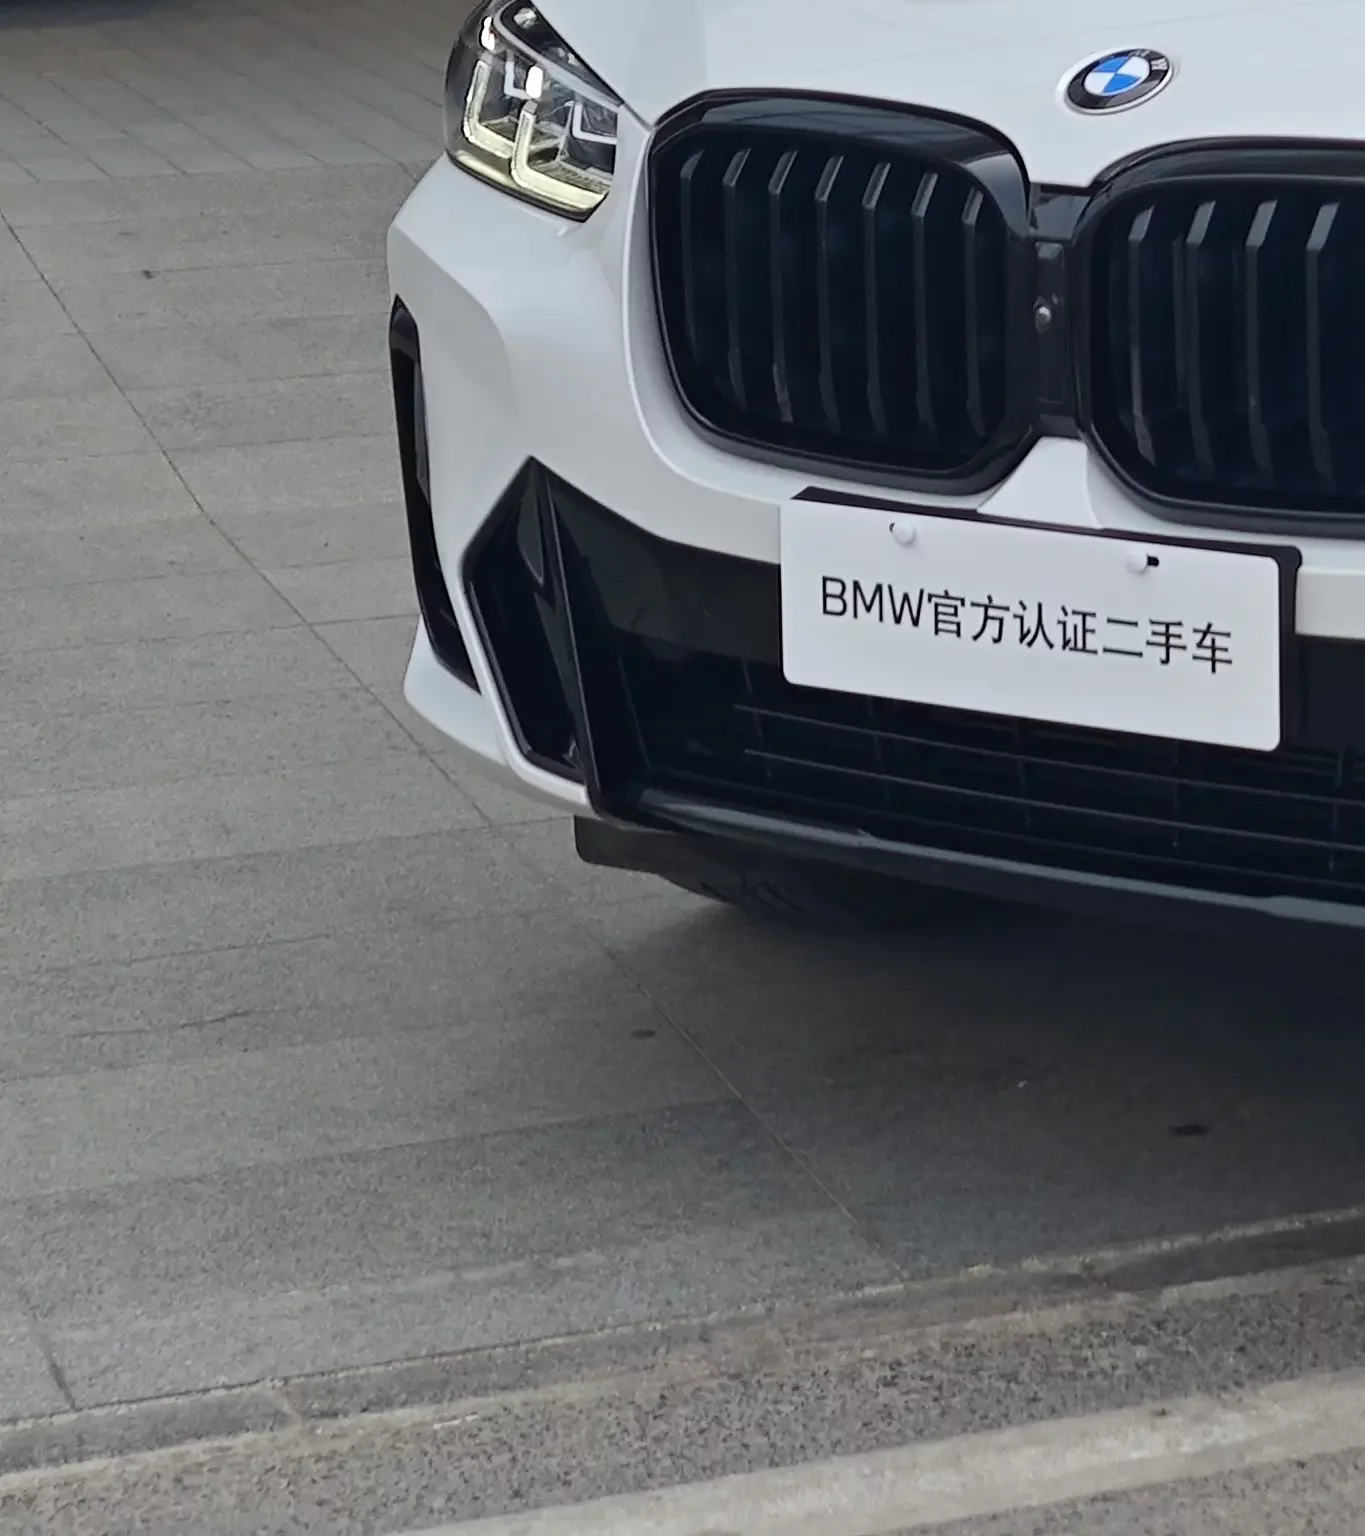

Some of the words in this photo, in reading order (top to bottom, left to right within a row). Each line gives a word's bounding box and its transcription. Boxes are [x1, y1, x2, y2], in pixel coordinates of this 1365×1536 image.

[820, 575, 1234, 675] BMW官方认证二手车
